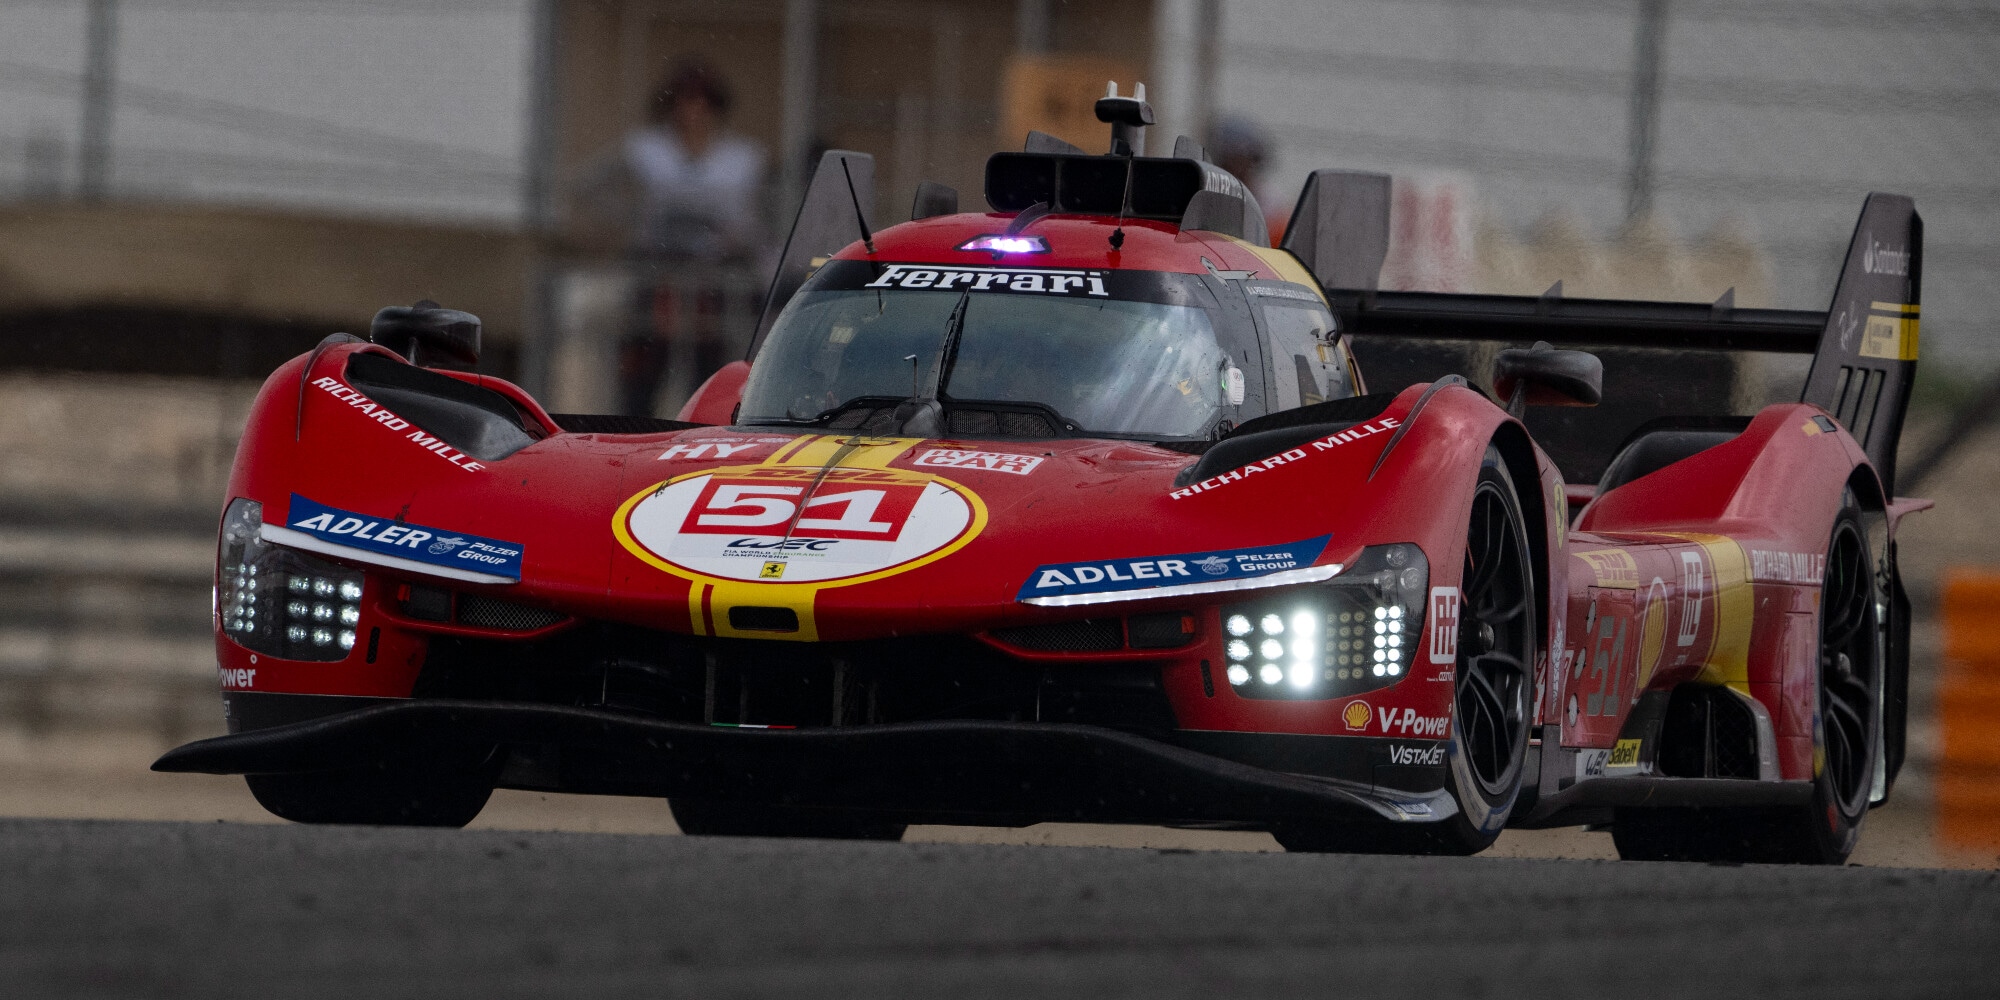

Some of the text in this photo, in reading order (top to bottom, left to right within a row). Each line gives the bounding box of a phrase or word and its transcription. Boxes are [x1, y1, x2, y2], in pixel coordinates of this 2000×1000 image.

[864, 264, 1109, 296] Ferrari
[312, 376, 486, 473] RICHARD MILLE
[657, 443, 760, 461] HY
[929, 450, 1036, 464] HYPER
[1170, 417, 1402, 500] RICHARD MILLE
[922, 455, 1028, 473] CAR
[696, 484, 893, 533] 51
[293, 512, 432, 549] ADLER
[468, 541, 519, 558] PELZER
[726, 537, 840, 551] WEC
[456, 549, 507, 566] GROUP
[1236, 551, 1293, 563] PELZER
[1240, 560, 1297, 572] GROUP
[1036, 559, 1191, 588] ADLER
[1586, 616, 1626, 716] 51
[1378, 706, 1449, 736] V-Power
